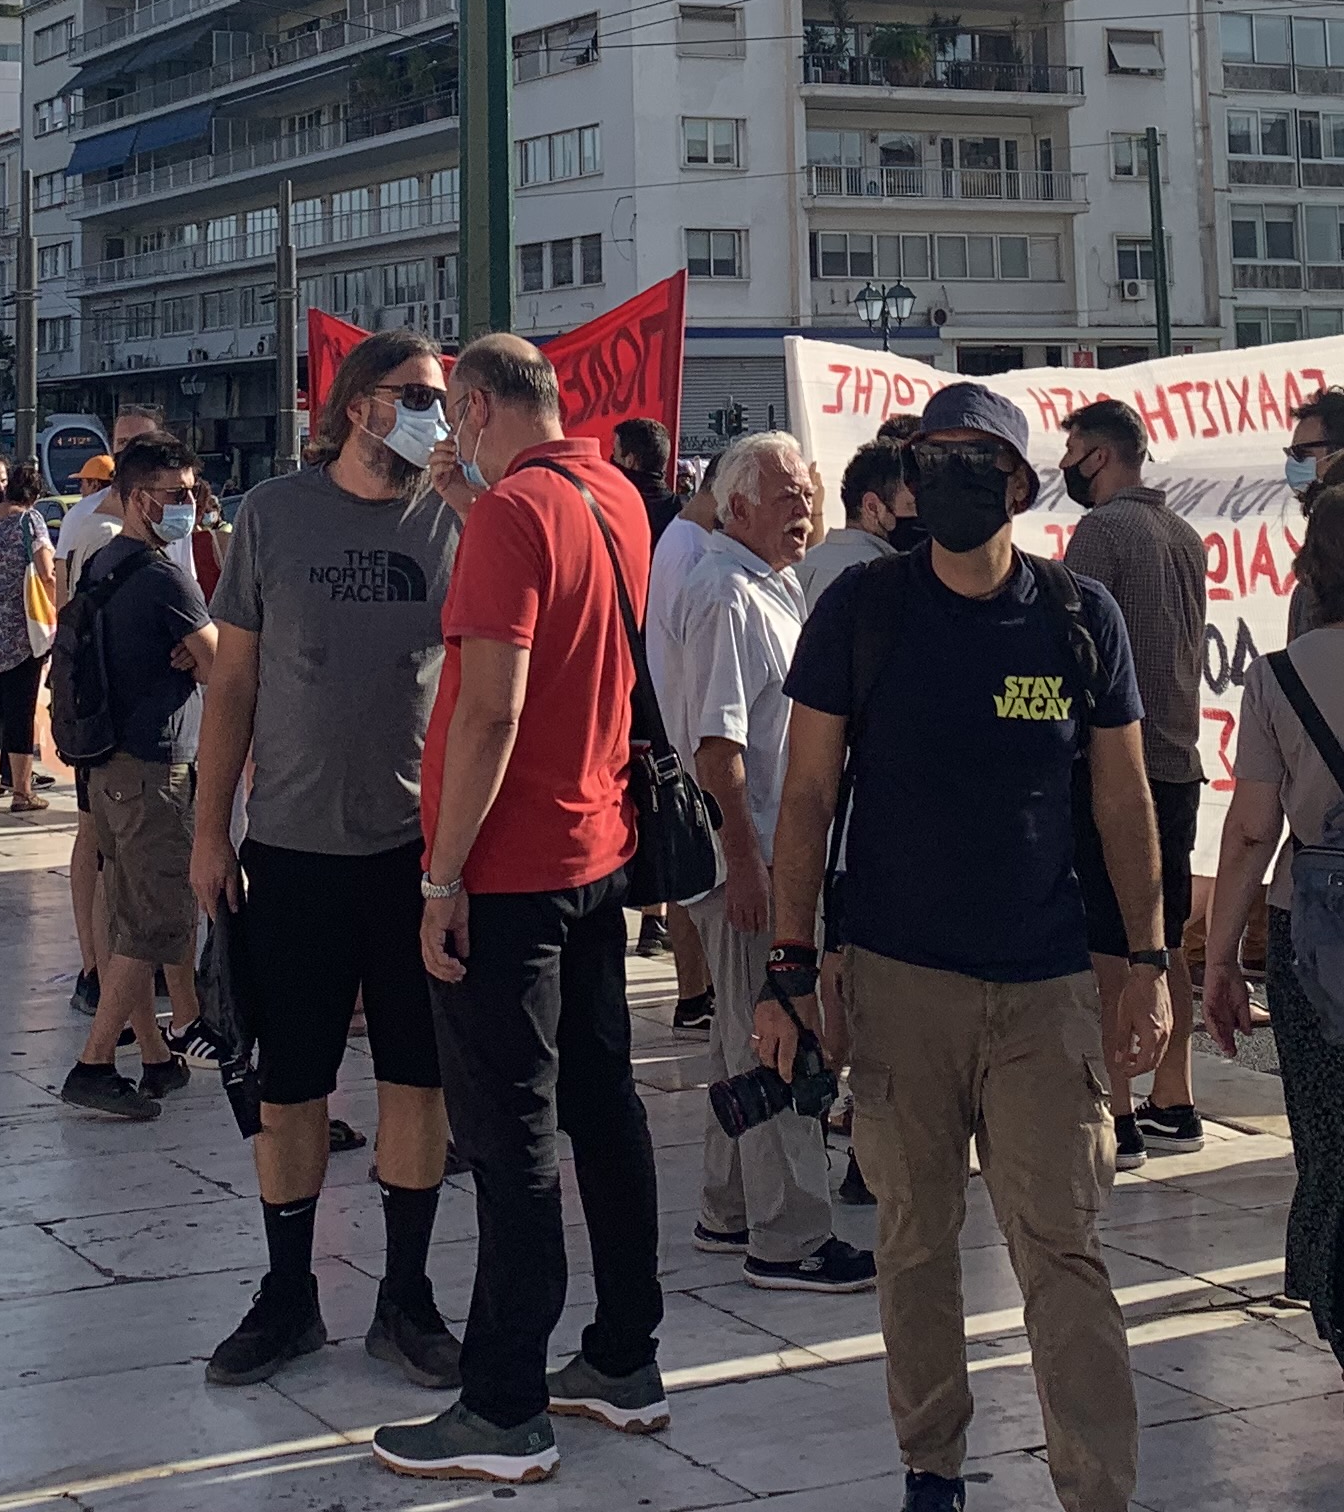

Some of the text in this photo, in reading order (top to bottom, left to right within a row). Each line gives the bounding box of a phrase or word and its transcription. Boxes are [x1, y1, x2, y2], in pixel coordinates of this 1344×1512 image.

[343, 549, 386, 567] THE
[308, 566, 386, 584] NORTH
[329, 583, 386, 602] FACE
[1003, 675, 1064, 699] STAY
[992, 694, 1073, 721] VACAY
